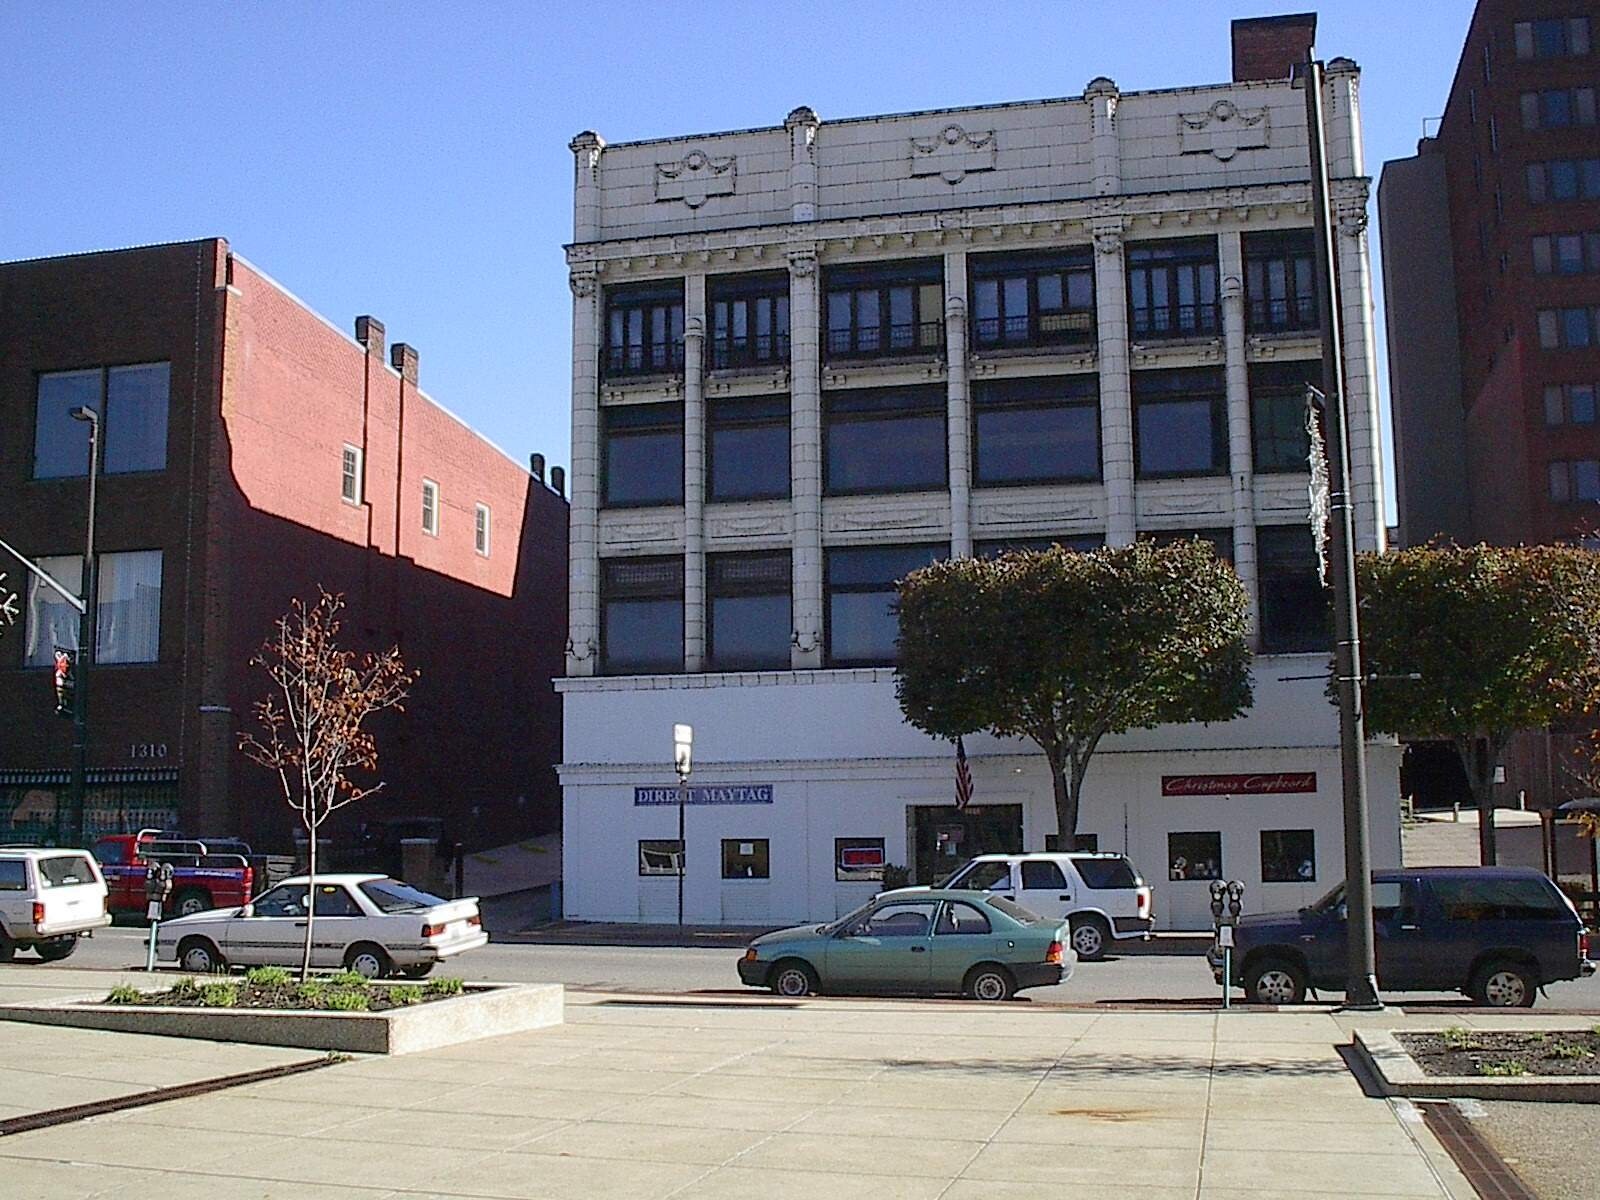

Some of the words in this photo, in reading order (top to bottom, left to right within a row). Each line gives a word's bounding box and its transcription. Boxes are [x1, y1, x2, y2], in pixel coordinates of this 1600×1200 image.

[131, 744, 168, 758] 1310
[1165, 777, 1238, 792] Christmas
[1243, 775, 1313, 792] Cupboard
[702, 787, 769, 802] MAYTAG
